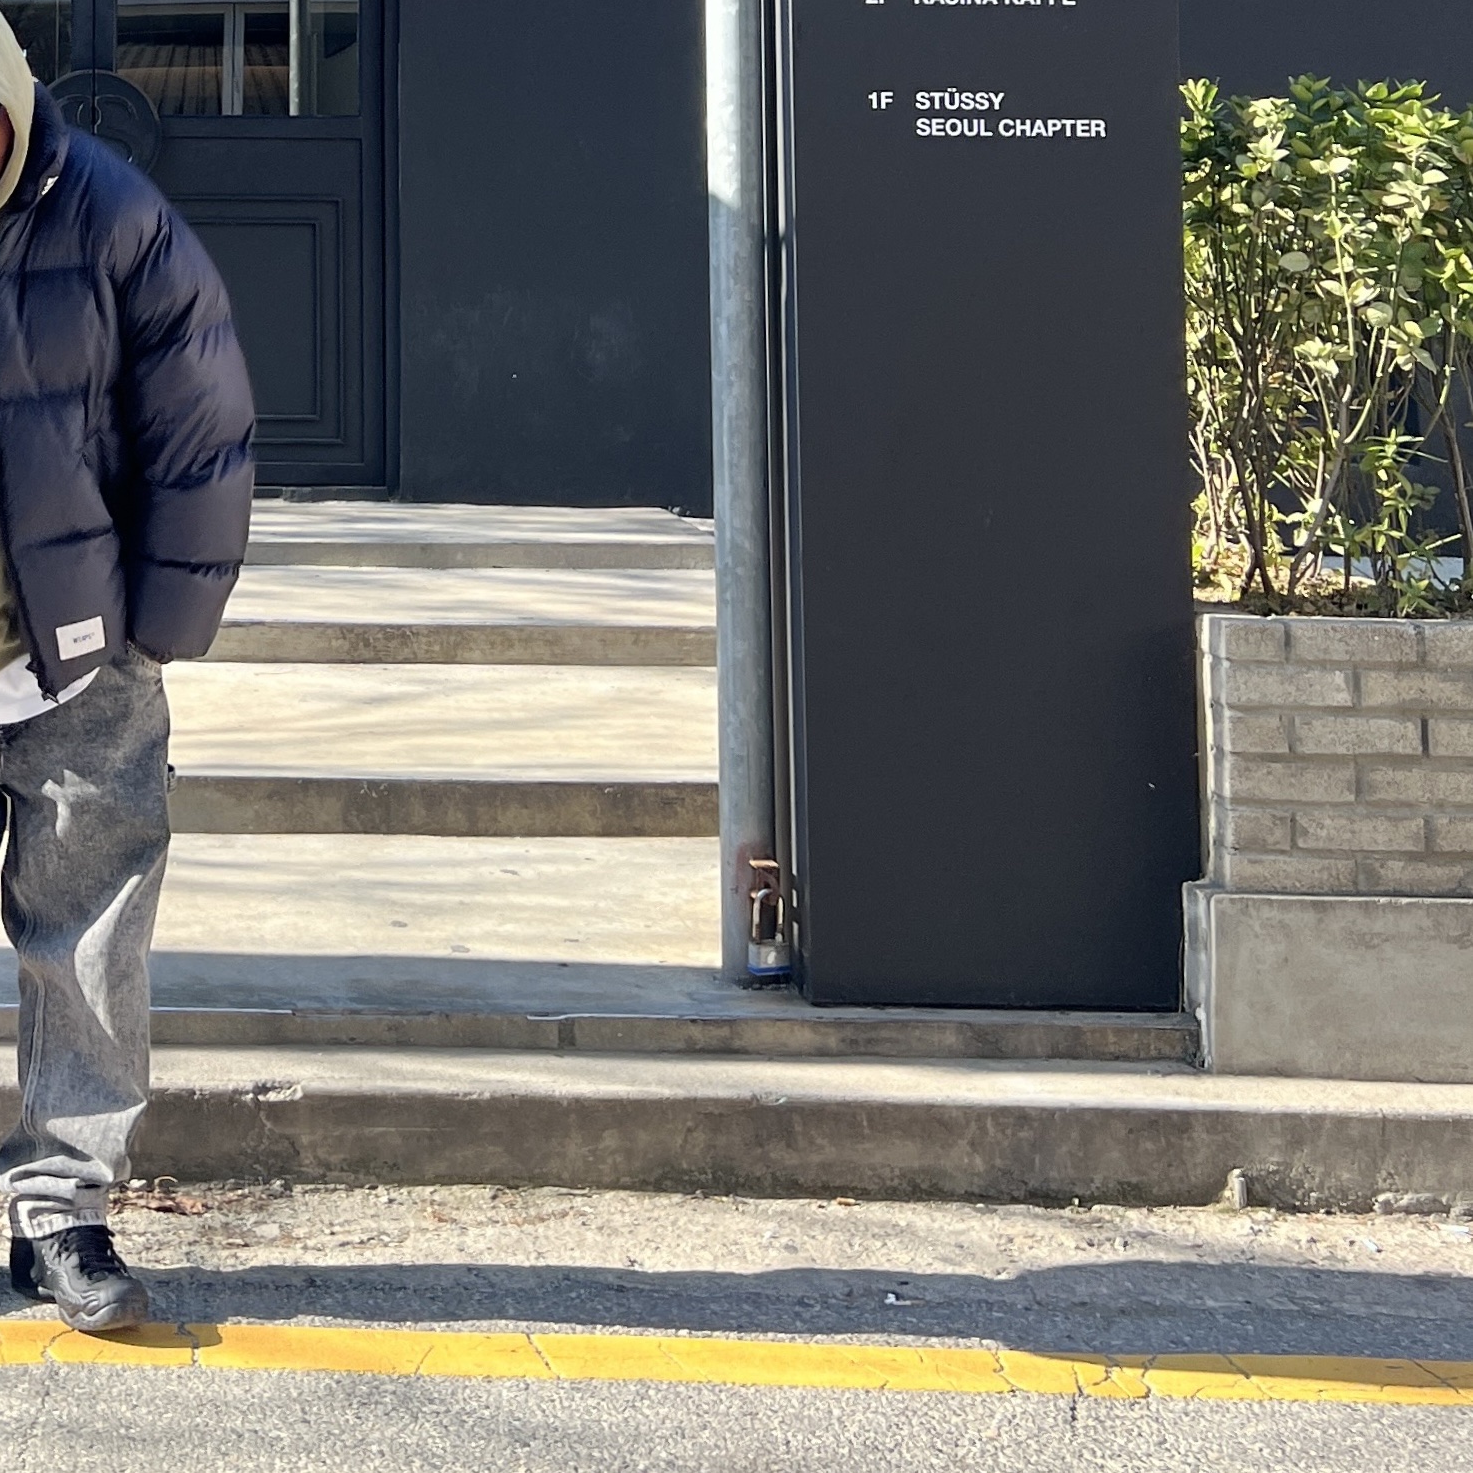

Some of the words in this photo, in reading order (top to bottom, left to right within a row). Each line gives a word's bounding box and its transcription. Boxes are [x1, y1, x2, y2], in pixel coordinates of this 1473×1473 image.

[867, 91, 894, 110] 1F
[914, 87, 1005, 111] STÜSSY
[915, 117, 993, 138] SEOUL
[998, 118, 1106, 138] CHAPTER
